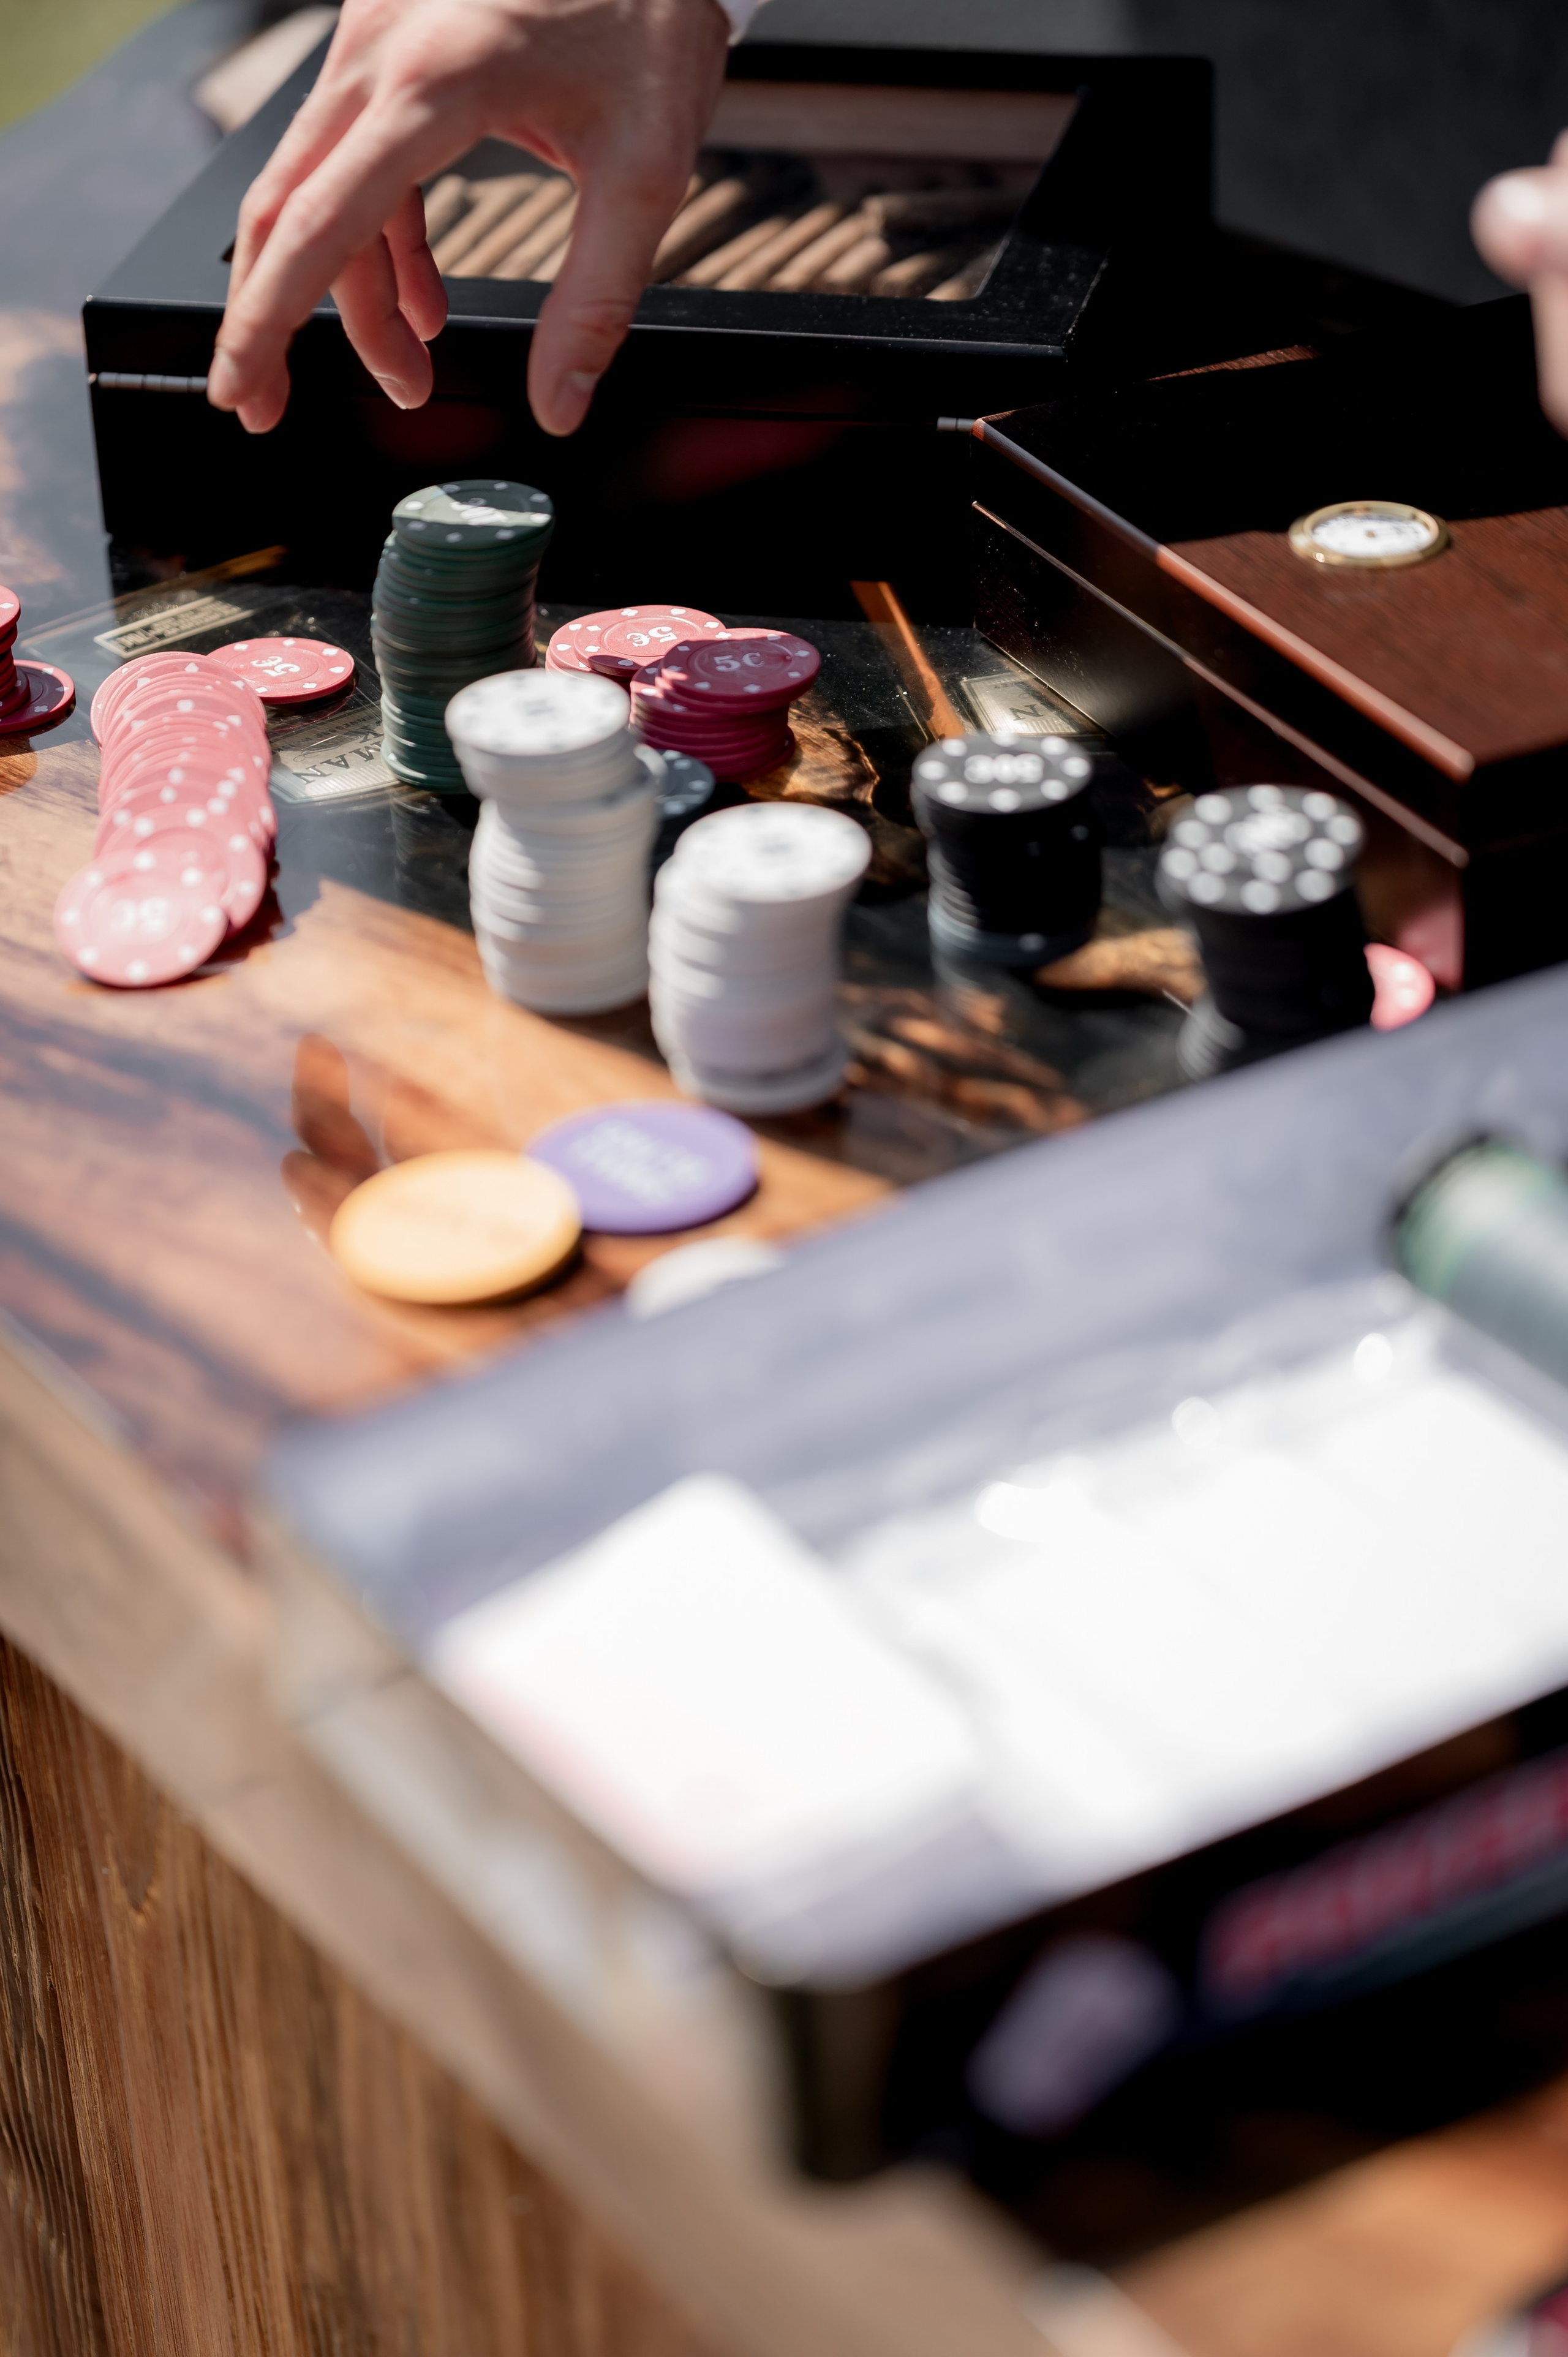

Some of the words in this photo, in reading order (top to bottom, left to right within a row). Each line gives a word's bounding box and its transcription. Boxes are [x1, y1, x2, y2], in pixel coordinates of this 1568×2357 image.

[626, 626, 678, 647] 5€
[250, 655, 300, 677] 5€
[714, 652, 765, 672] 5€
